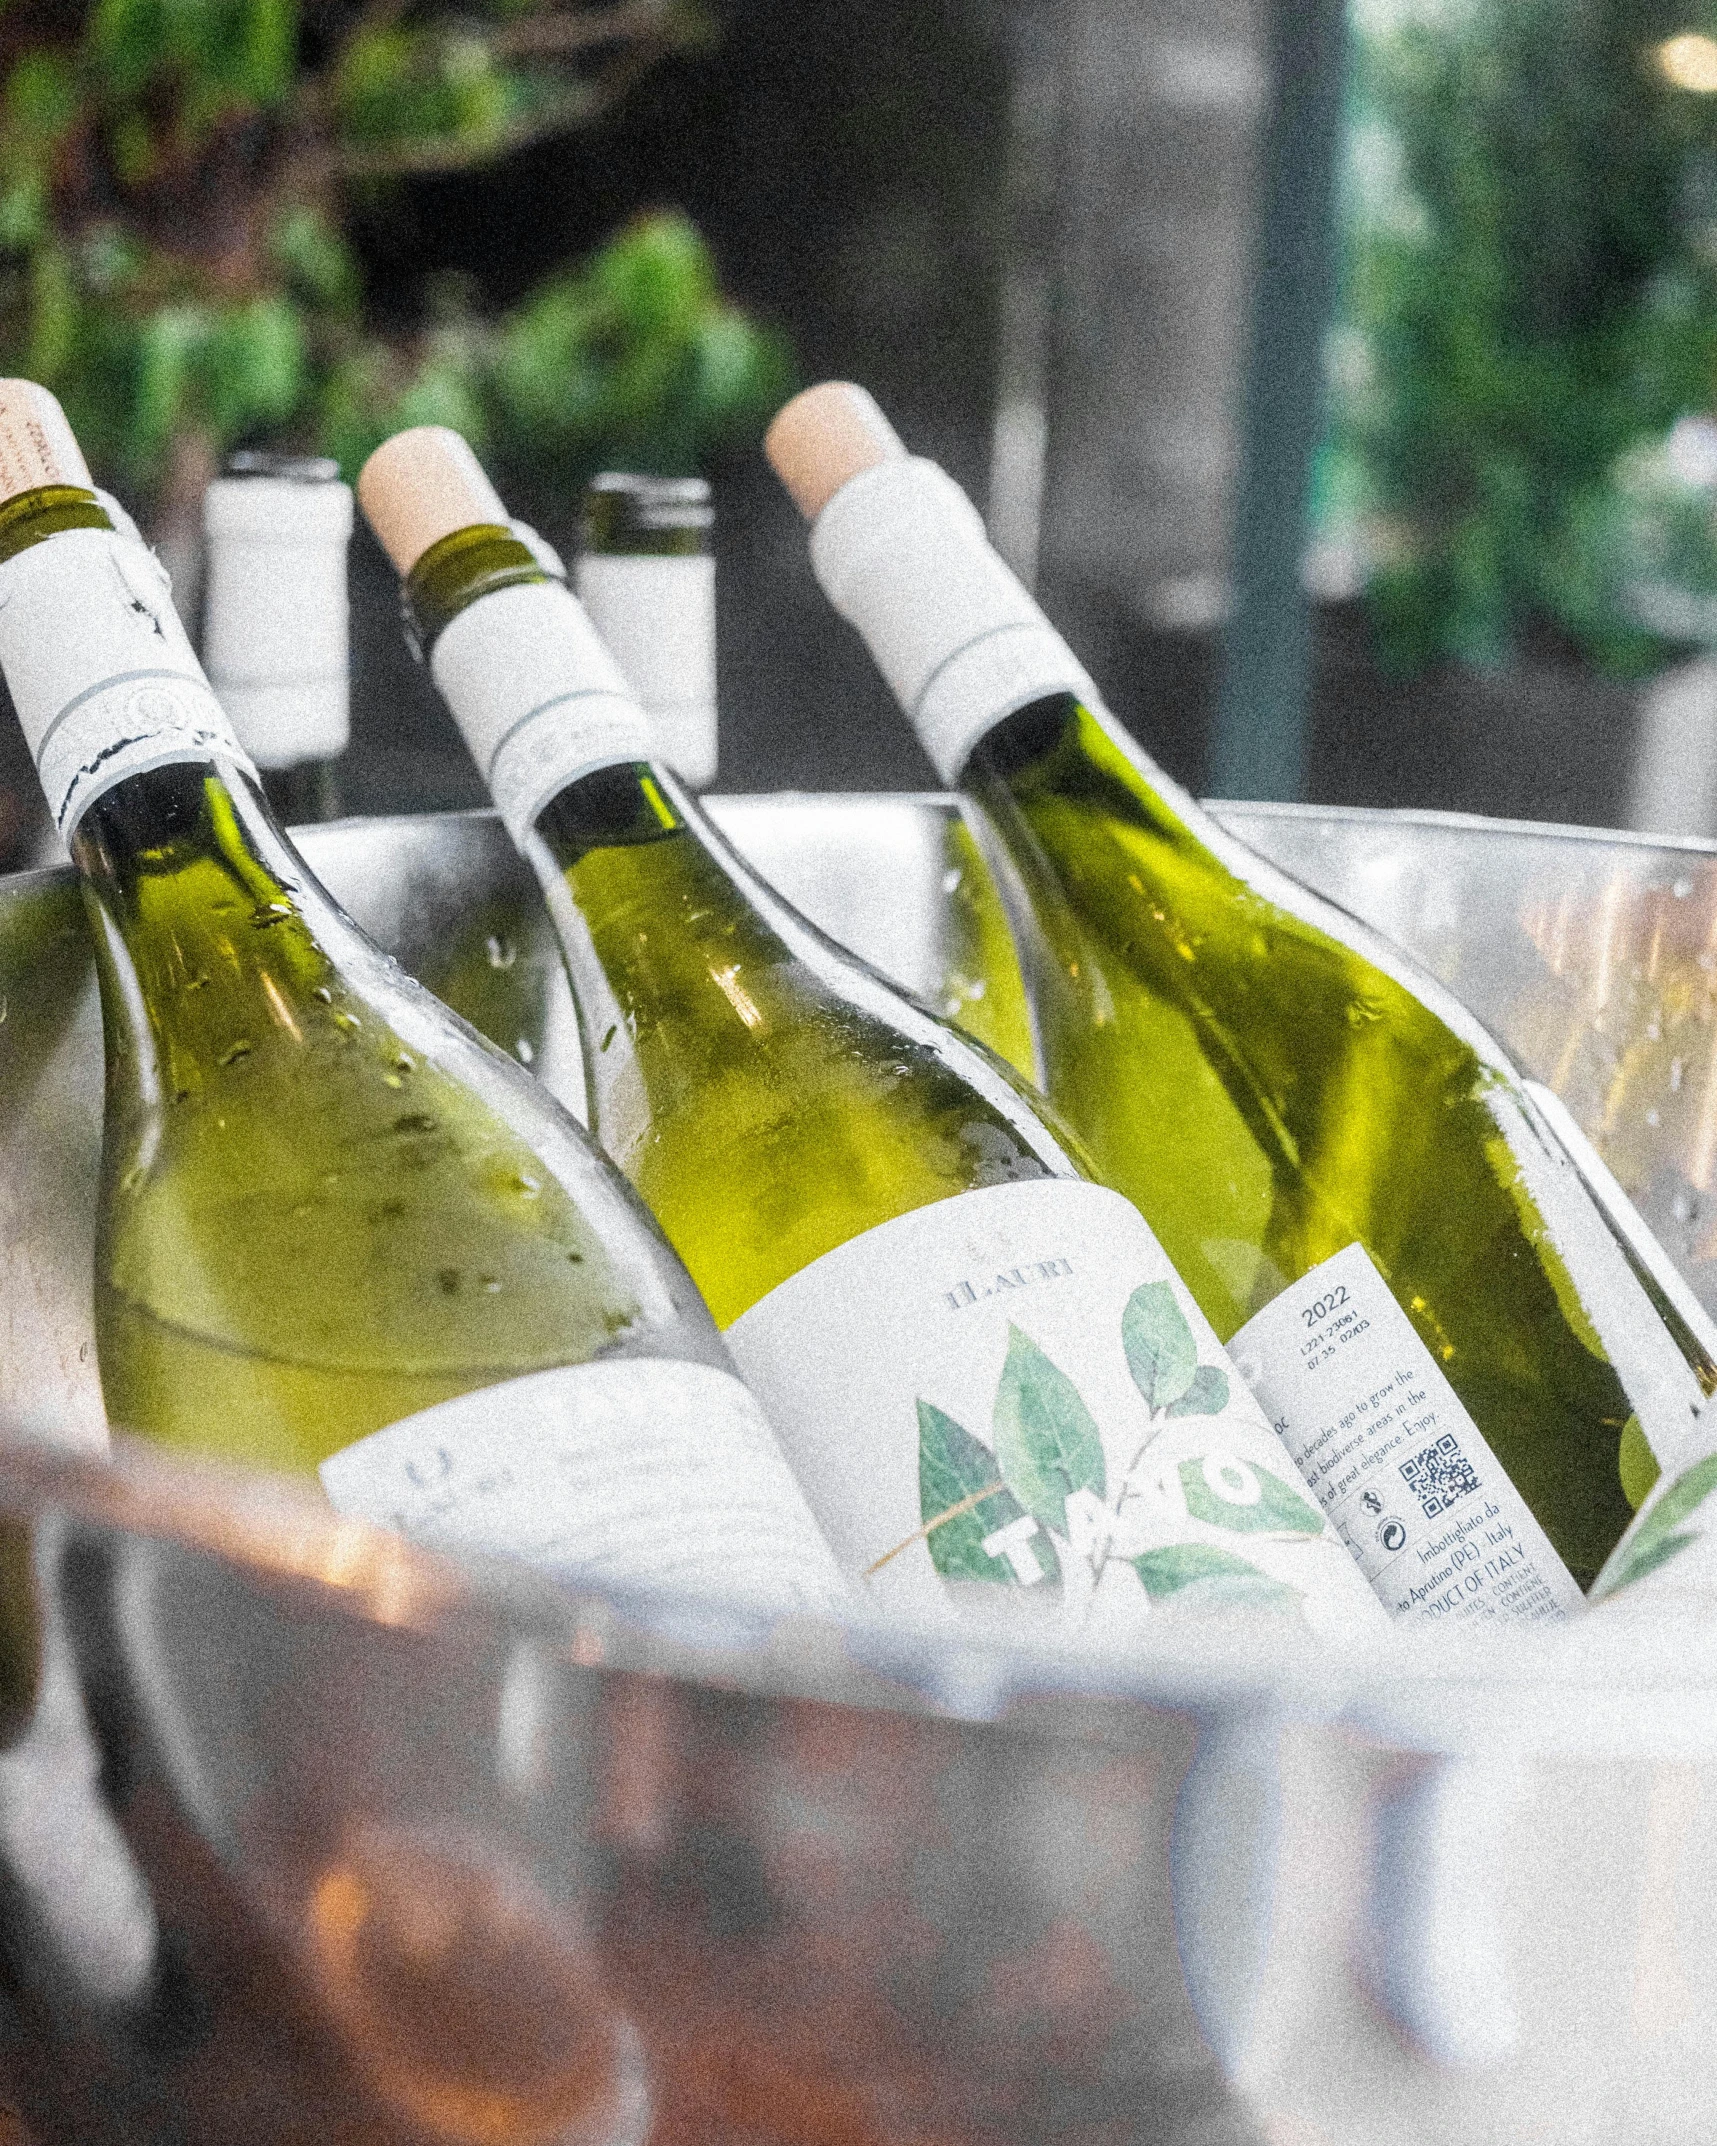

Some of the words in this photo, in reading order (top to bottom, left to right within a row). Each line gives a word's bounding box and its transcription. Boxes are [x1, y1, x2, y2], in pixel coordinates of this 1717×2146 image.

[1301, 1285, 1351, 1328] 2022
[1303, 1425, 1338, 1459] decades
[1338, 1412, 1356, 1430] ago
[1355, 1401, 1369, 1415] to
[1370, 1382, 1394, 1408] grow
[1394, 1370, 1414, 1387] the
[1316, 1433, 1365, 1475] biodiverse
[1367, 1412, 1394, 1436] areas
[1395, 1403, 1407, 1416] in
[1407, 1389, 1427, 1406] the
[1327, 1481, 1338, 1500] of
[1337, 1465, 1361, 1494] great
[1397, 1599, 1411, 1613] to
[1409, 1565, 1454, 1604] Aprutino
[1450, 1541, 1482, 1572] (PE)
[1484, 1522, 1514, 1546] Italy
[1416, 1514, 1484, 1565] Imbottigliato
[1484, 1501, 1501, 1519] da
[1418, 1584, 1466, 1623] ODUCT
[1464, 1568, 1485, 1593] OF
[1484, 1542, 1526, 1580] ITALY
